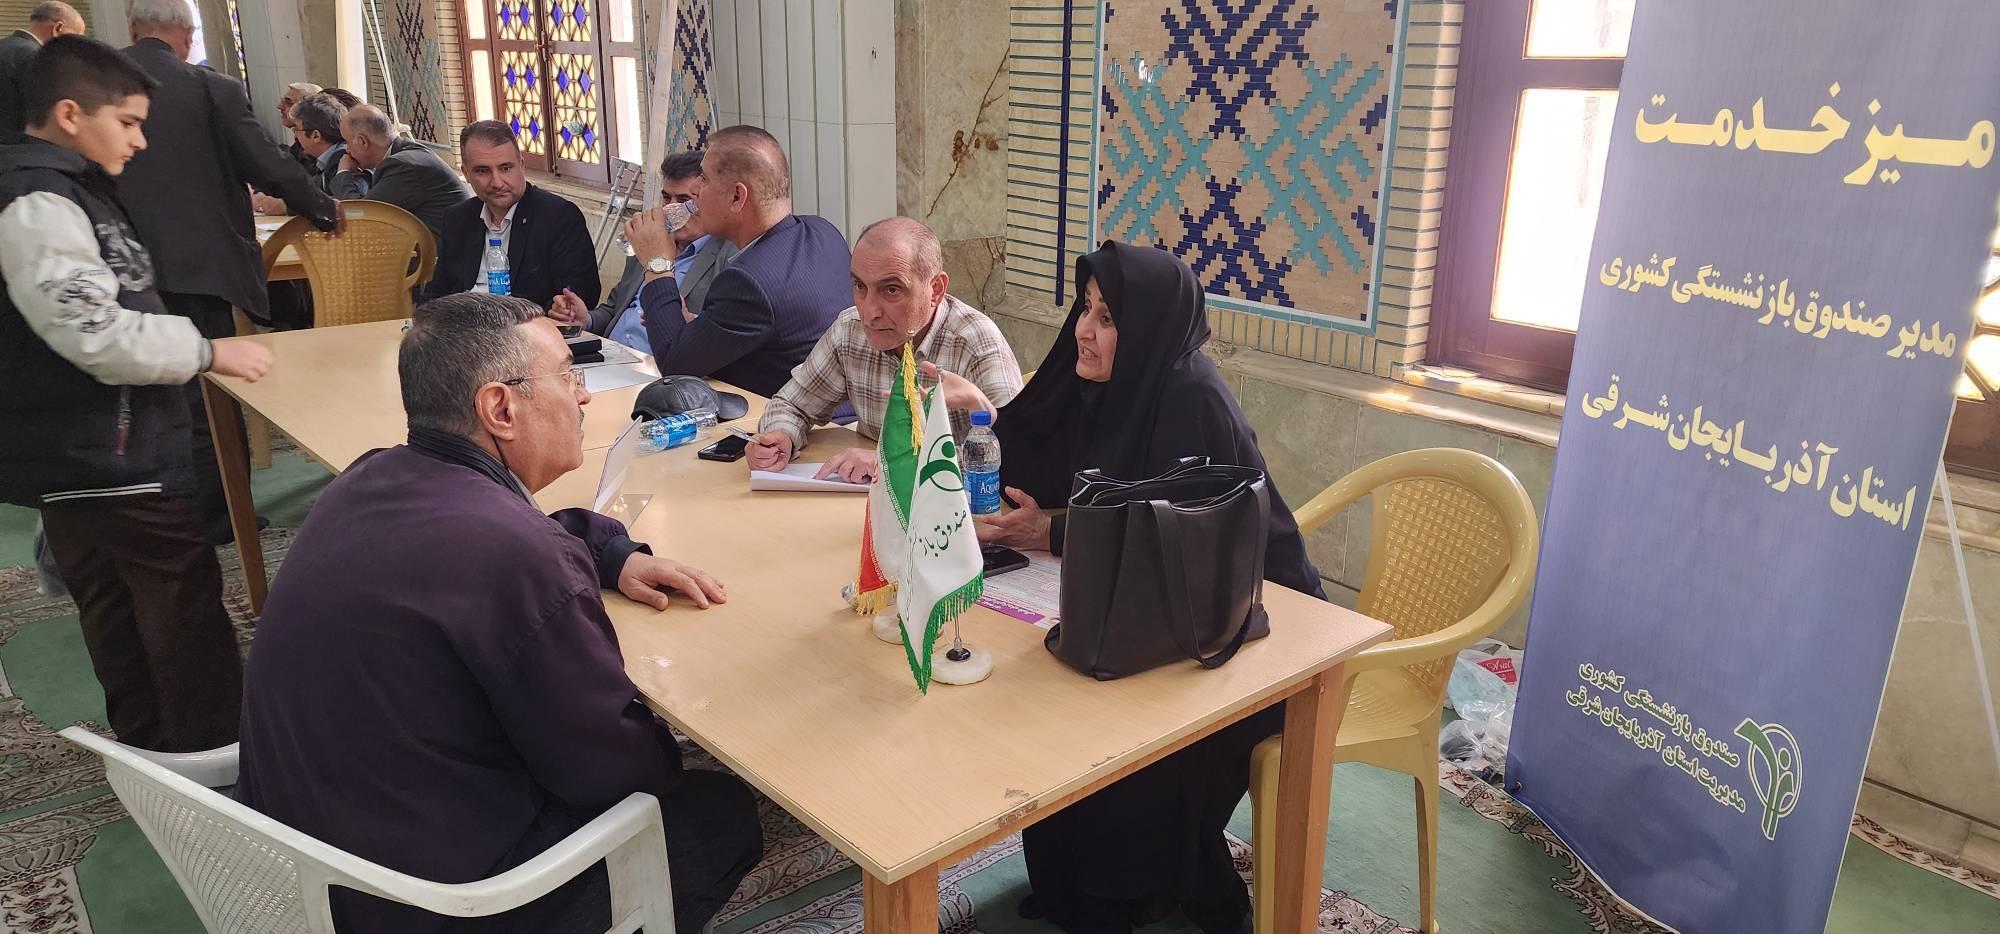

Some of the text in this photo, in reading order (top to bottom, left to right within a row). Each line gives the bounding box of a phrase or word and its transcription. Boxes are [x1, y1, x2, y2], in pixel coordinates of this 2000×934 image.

[1635, 81, 1995, 185] میز خدمت
[1600, 253, 1956, 360] مدیر صندوق بازنشستگی کشوری
[1582, 374, 1916, 531] استان آذربایجان شرقی
[934, 510, 967, 551] صندوق
[1566, 686, 1746, 813] مدیریت استان آذربایجان شرقی
[1579, 663, 1740, 767] صندوق بازنشستگی کشوری
